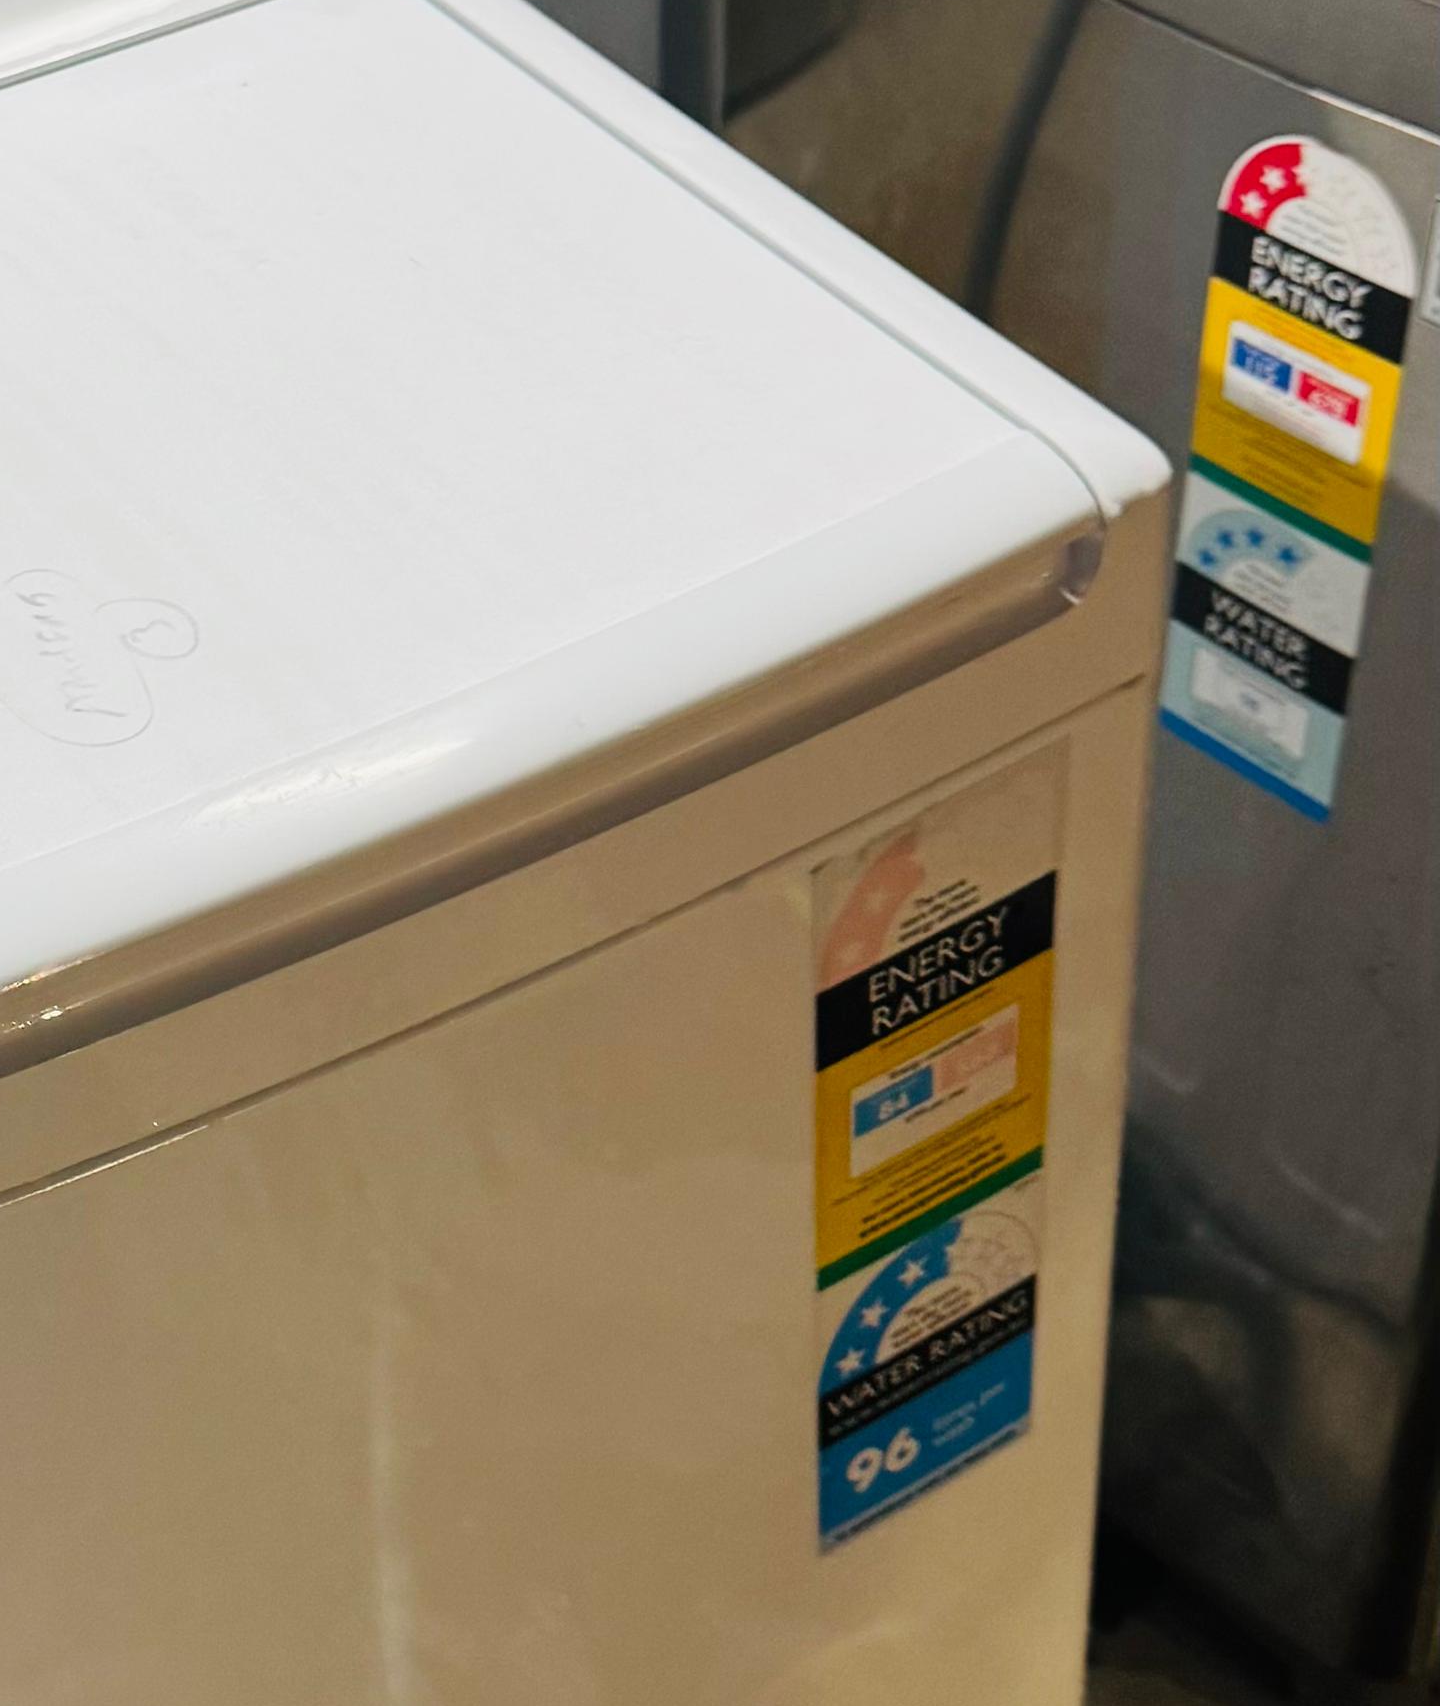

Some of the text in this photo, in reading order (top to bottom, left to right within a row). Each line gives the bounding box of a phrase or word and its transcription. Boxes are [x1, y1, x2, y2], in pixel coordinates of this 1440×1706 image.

[1247, 265, 1366, 340] RATING
[1251, 235, 1374, 308] ENERGY
[1203, 613, 1308, 690] RATING
[1210, 590, 1307, 661] WATER
[869, 907, 1008, 1003] ENERGY
[872, 945, 1004, 1035] RATING
[826, 1353, 921, 1417] WATER
[928, 1289, 1030, 1362] RATING
[846, 1427, 922, 1493] 96
